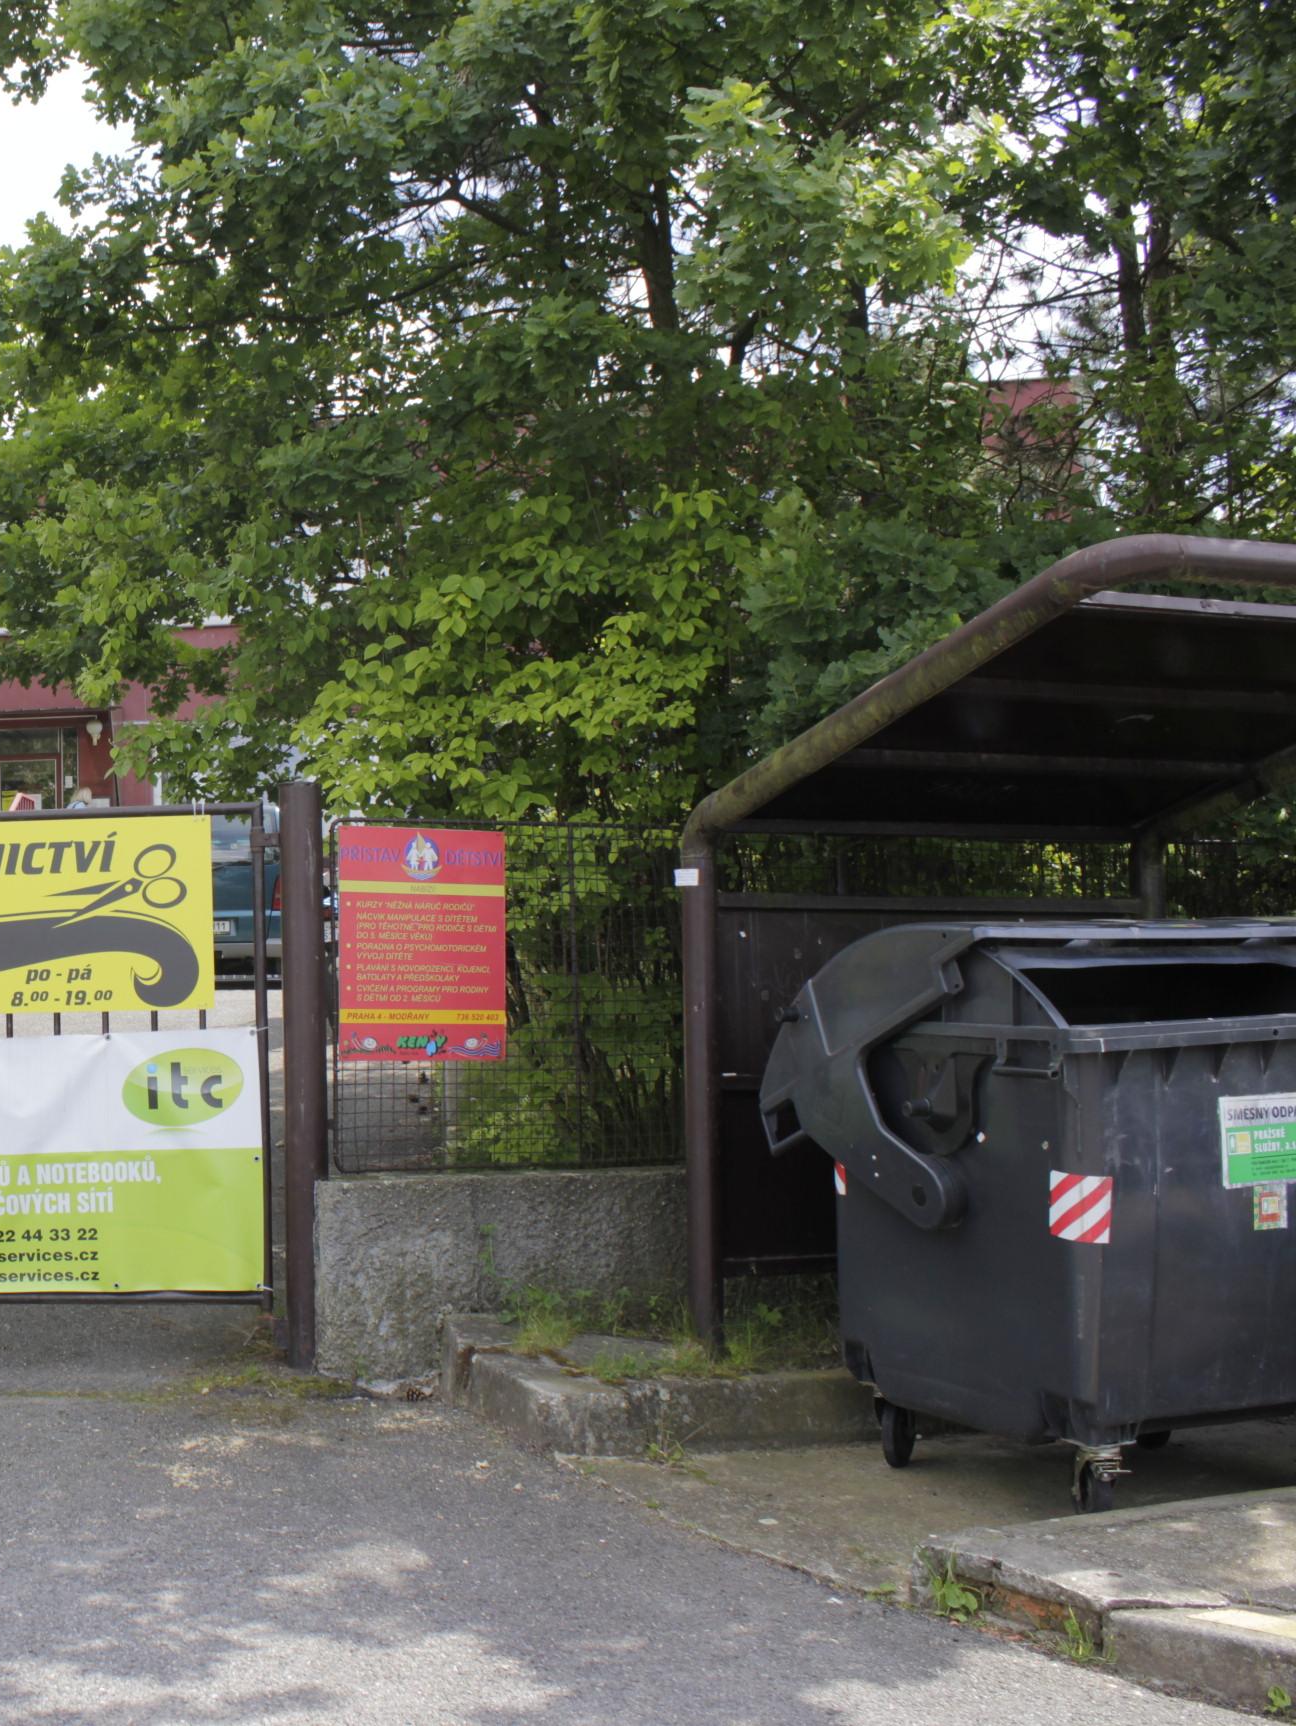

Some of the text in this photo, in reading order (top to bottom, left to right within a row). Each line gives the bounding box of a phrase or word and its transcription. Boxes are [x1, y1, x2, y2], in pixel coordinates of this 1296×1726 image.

[25, 968, 51, 985] po
[67, 964, 92, 985] pá
[347, 1012, 376, 1020] PRAHA
[389, 1011, 430, 1020] MODŘANY
[146, 1063, 223, 1110] itc
[17, 1165, 31, 1186] A
[36, 1152, 162, 1185] NOTEBOOKŮ,
[77, 1186, 114, 1213] SÍTÍ
[21, 1229, 43, 1242] 44
[49, 1228, 72, 1242] 33
[77, 1228, 98, 1241] 22
